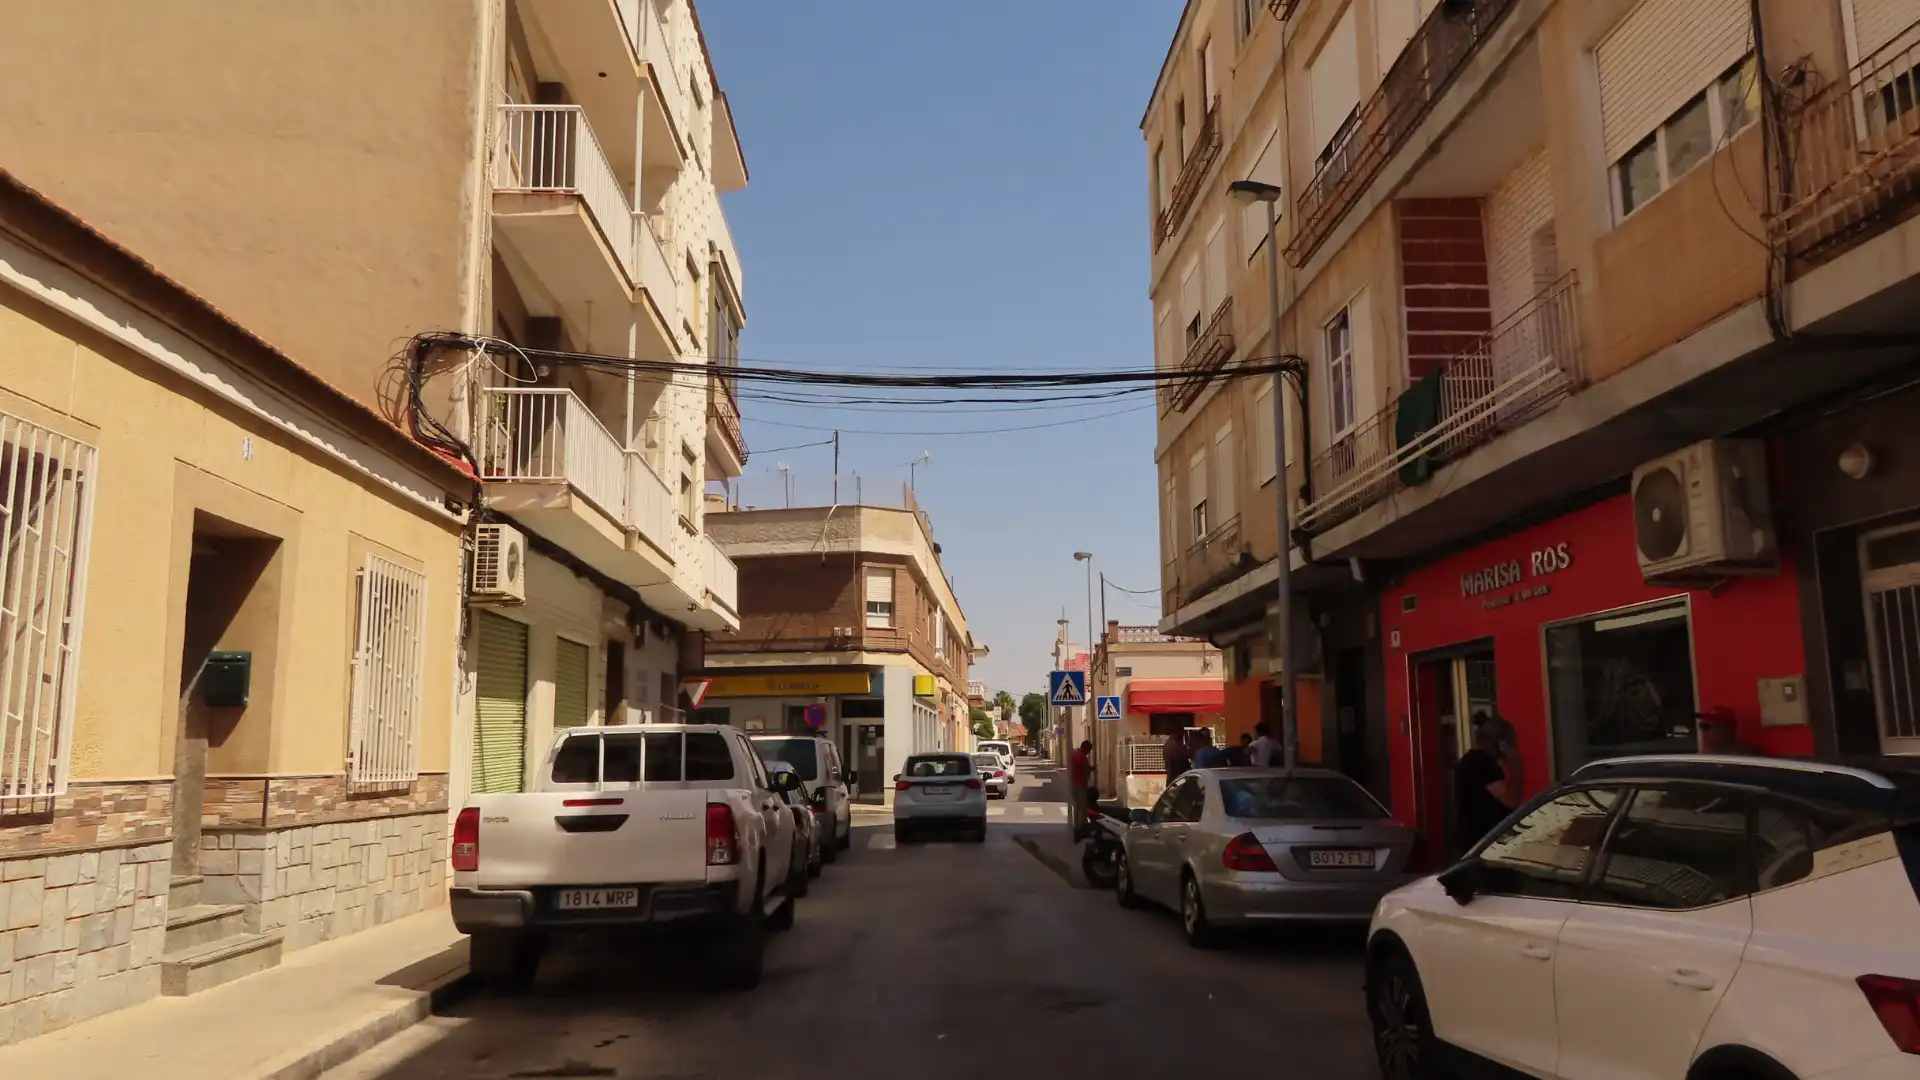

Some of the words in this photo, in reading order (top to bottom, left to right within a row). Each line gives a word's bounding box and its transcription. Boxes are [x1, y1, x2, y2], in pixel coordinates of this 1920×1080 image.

[1460, 560, 1520, 598] MARISA
[1531, 542, 1570, 576] ROS
[483, 816, 509, 824] TOYOTA
[1349, 852, 1373, 864] FTJ
[564, 891, 601, 907] 1814
[606, 890, 635, 905] MRP
